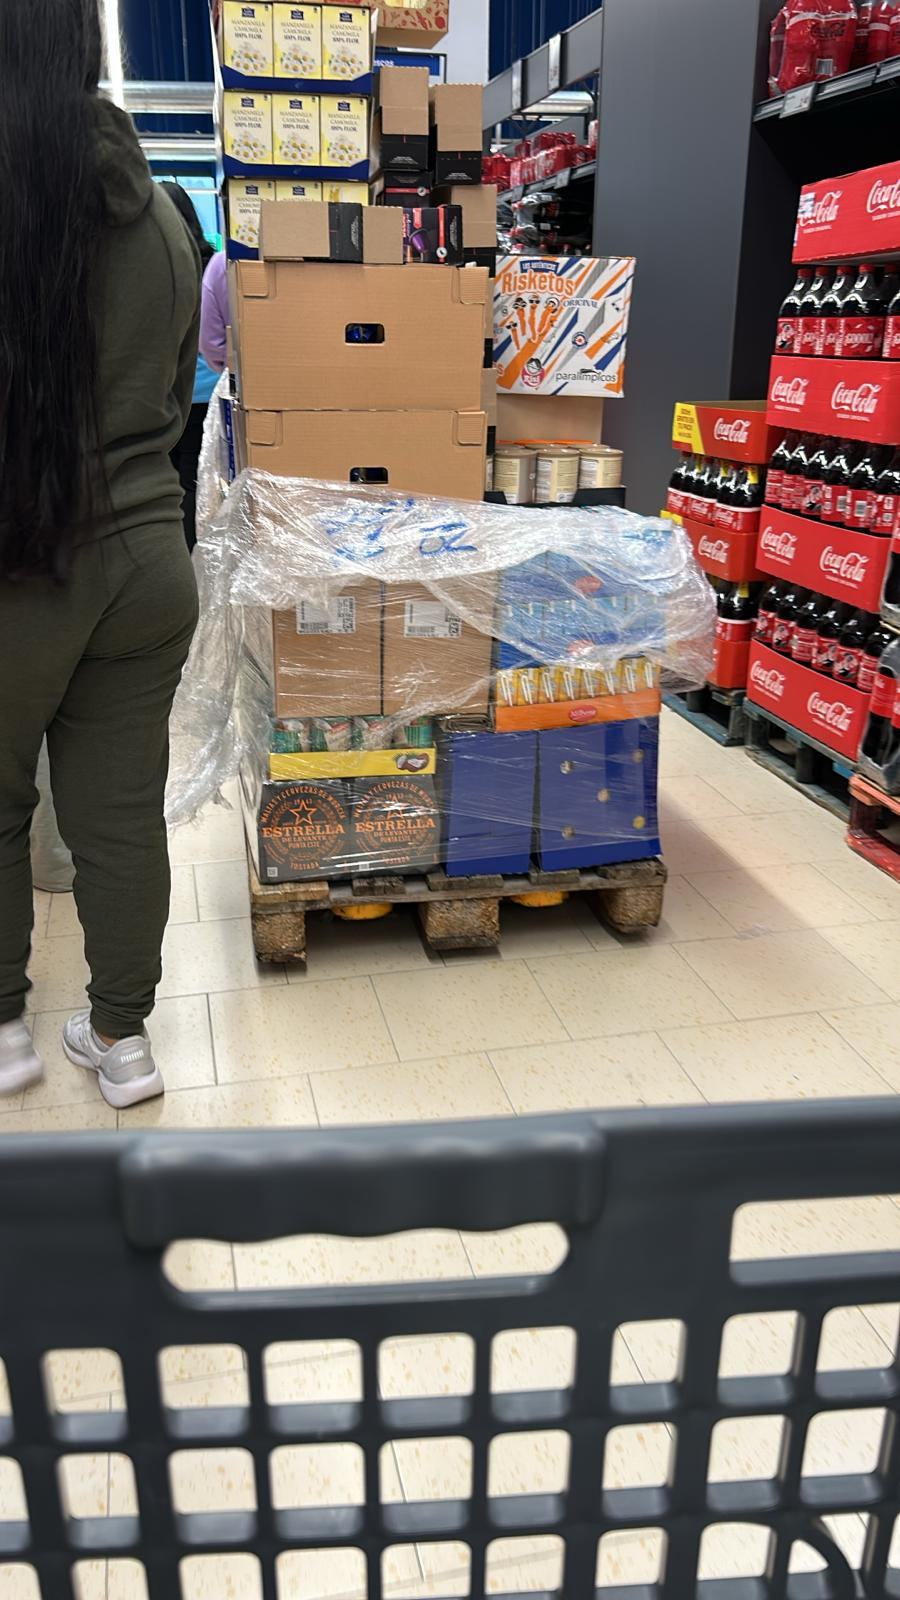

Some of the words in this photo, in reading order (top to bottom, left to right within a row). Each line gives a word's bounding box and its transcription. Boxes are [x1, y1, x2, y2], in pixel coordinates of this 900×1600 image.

[502, 269, 575, 297] Risketos
[563, 299, 598, 308] ORIGINAL
[279, 785, 318, 798] CERVEZAS
[372, 781, 410, 793] CERVEZAS
[262, 824, 345, 838] ESTRELLA
[355, 818, 436, 832] ESTRELLA
[120, 1049, 144, 1064] PUMA
